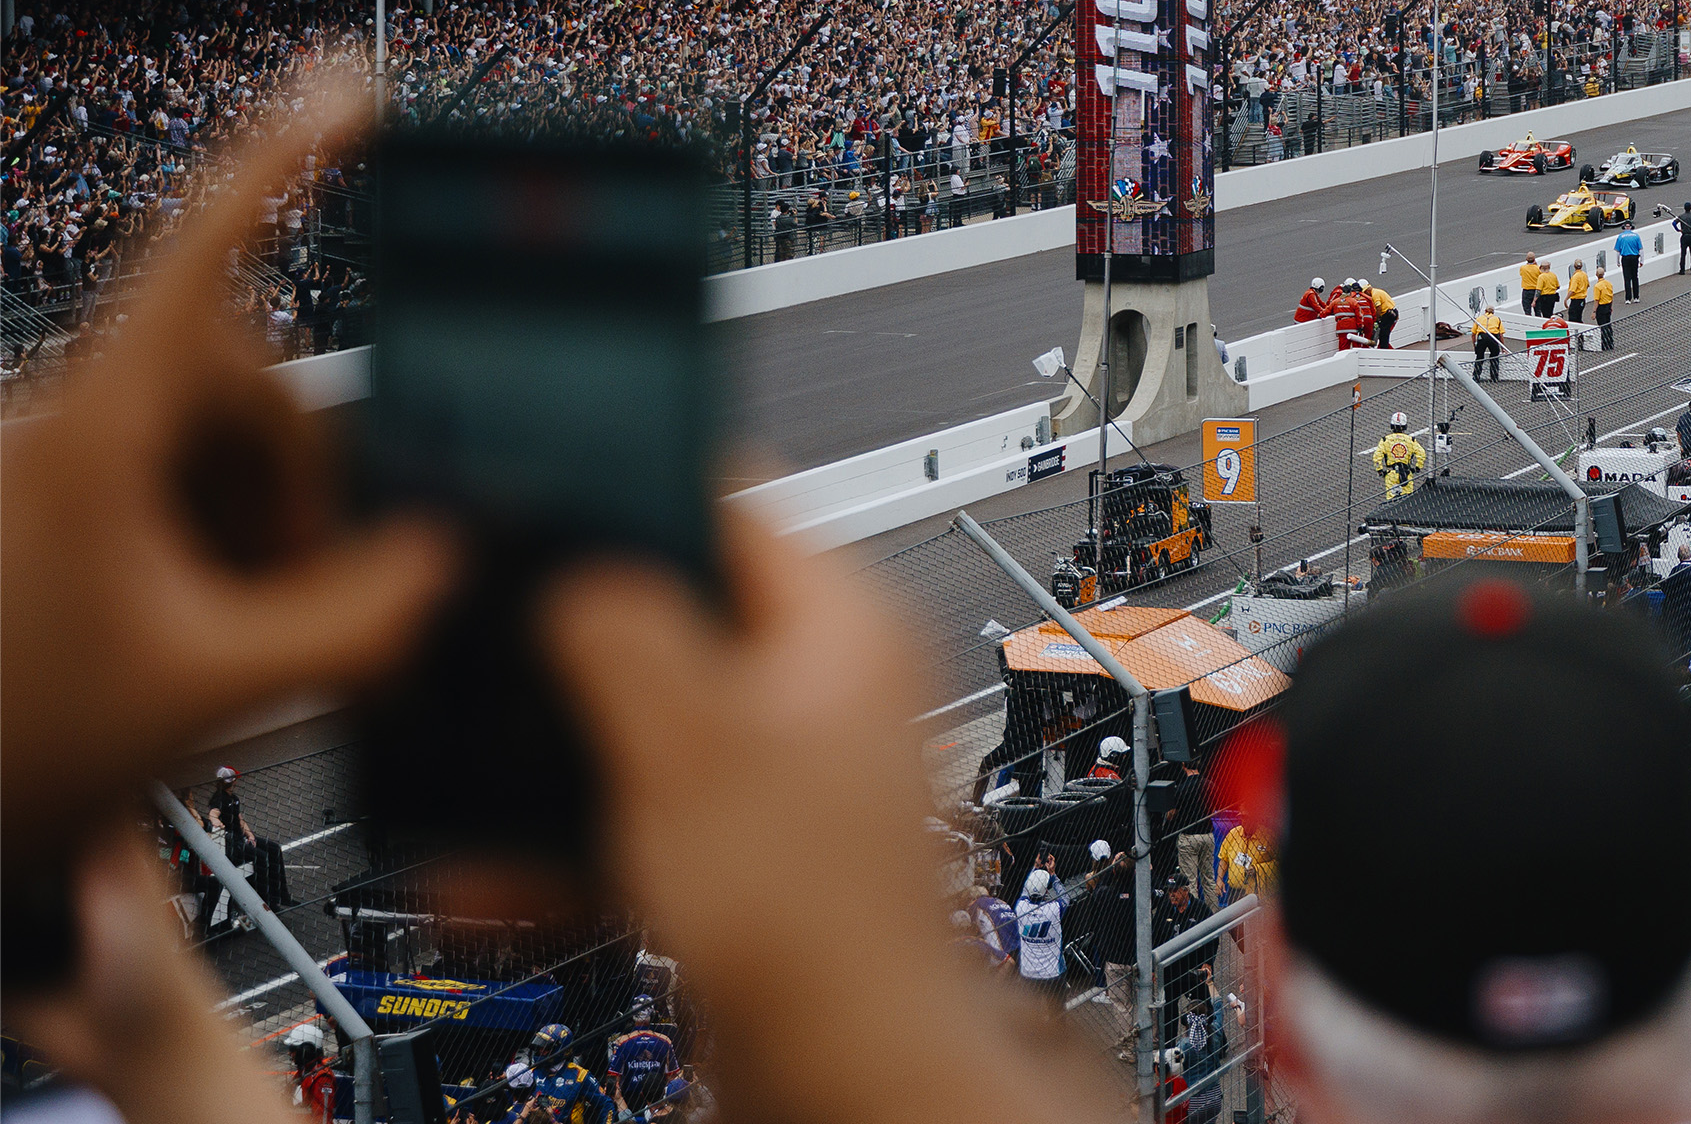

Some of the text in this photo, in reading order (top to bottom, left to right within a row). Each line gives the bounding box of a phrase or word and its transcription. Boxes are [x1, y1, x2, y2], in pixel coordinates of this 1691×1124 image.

[1533, 348, 1566, 378] 75
[1037, 455, 1060, 472] GAINBRIDGE
[1216, 448, 1241, 495] 9
[1498, 547, 1524, 557] BANK
[1264, 622, 1290, 634] PNC
[377, 995, 472, 1020] SUNOCO
